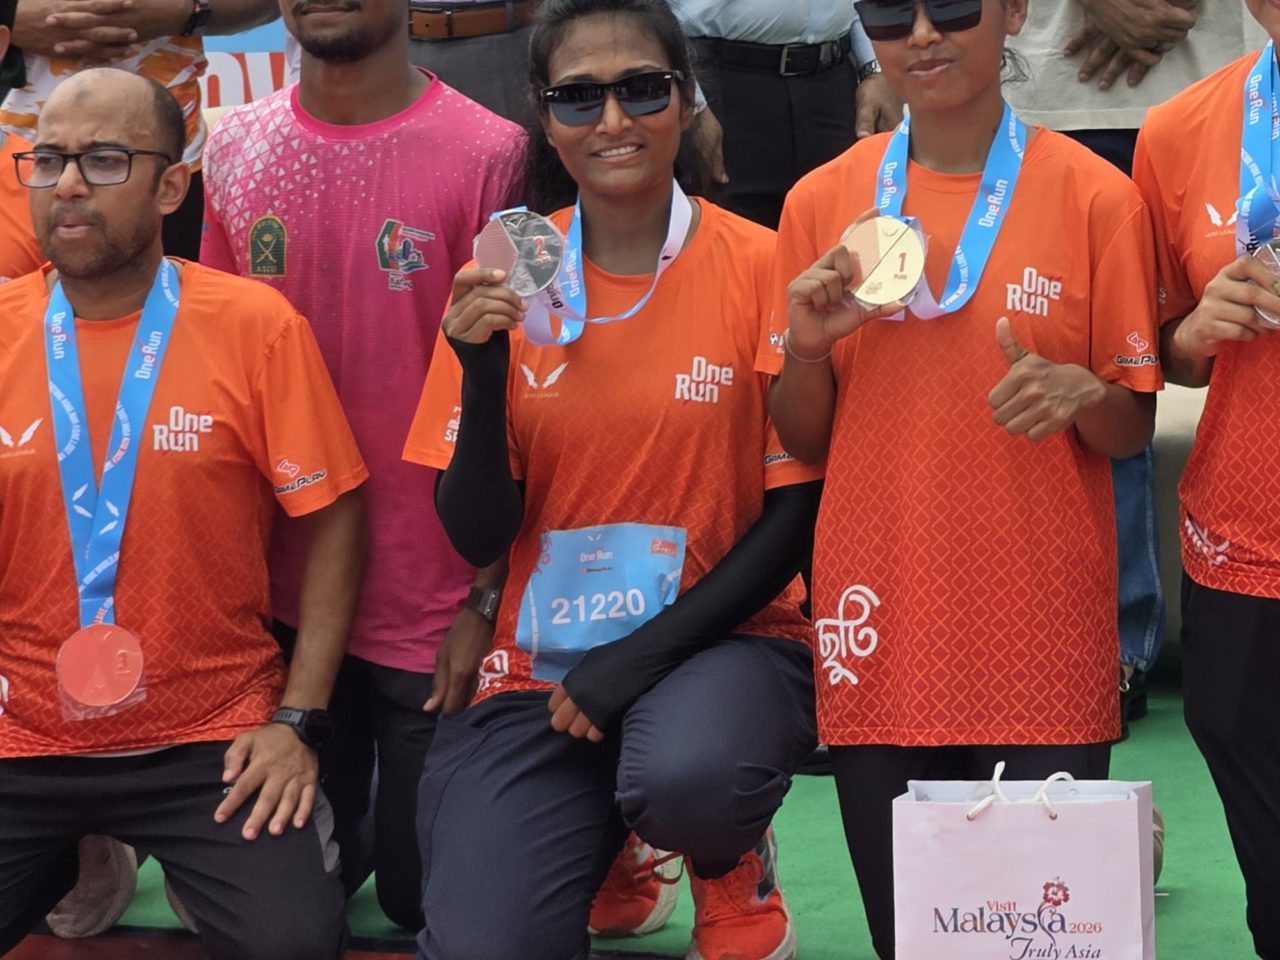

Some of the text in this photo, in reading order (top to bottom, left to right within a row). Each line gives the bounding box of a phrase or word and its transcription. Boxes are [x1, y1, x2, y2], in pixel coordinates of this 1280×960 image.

[898, 252, 907, 273] 1
[1022, 267, 1062, 300] One
[1006, 283, 1048, 317] Run
[692, 355, 734, 386] One
[675, 373, 719, 404] Run
[169, 405, 213, 433] One
[153, 424, 199, 452] Run
[551, 589, 646, 625] 21220
[986, 900, 1017, 912] Visit
[933, 904, 1102, 940] Malaysia 2026
[1009, 936, 1101, 960] Truly Asia
